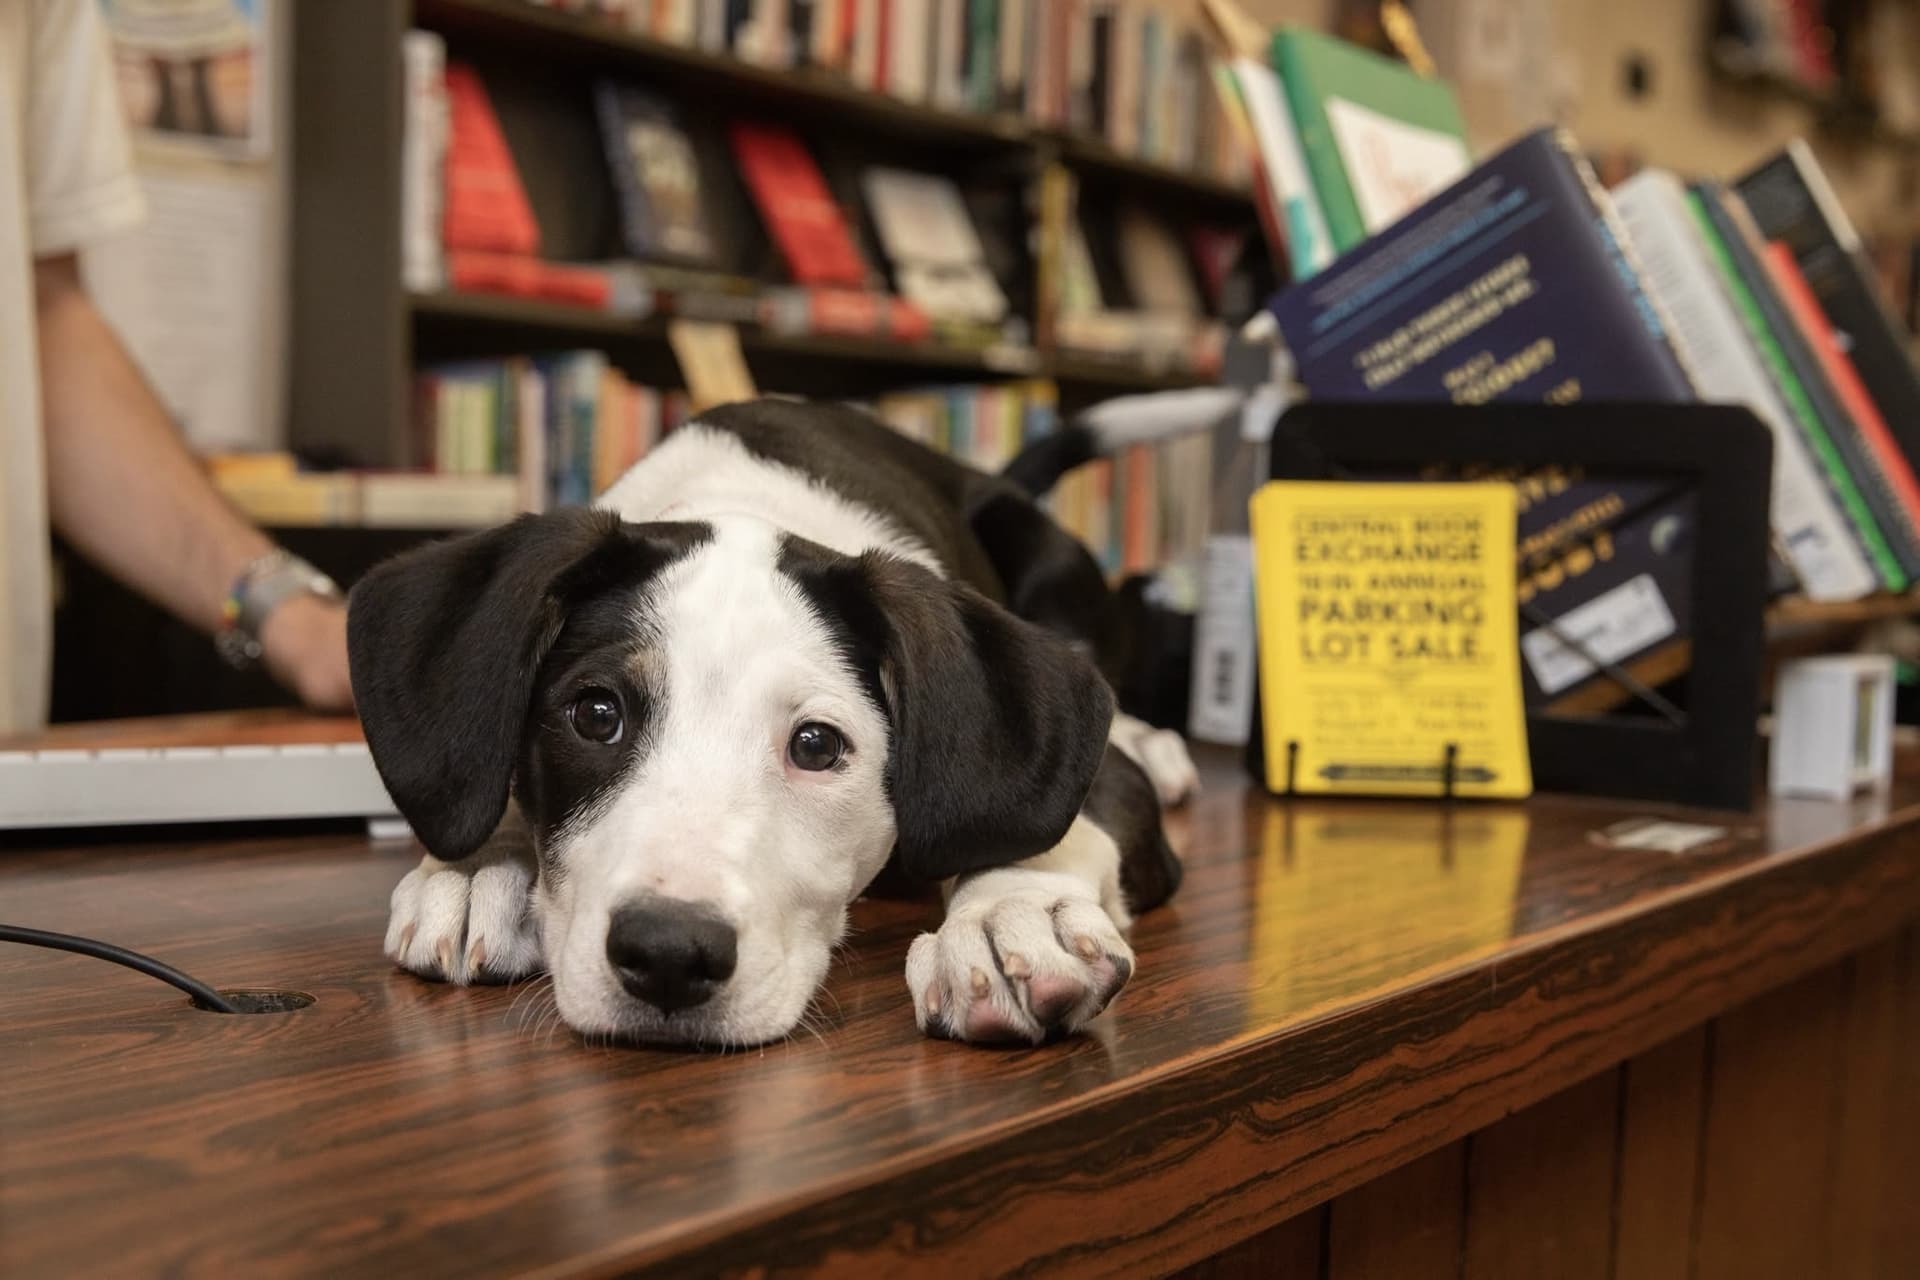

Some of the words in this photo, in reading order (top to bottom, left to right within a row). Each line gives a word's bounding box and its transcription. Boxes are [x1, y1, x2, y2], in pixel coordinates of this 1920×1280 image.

[1294, 540, 1485, 563] EXCHANGE
[1297, 596, 1486, 625] PARKING
[1299, 632, 1373, 661] LOT
